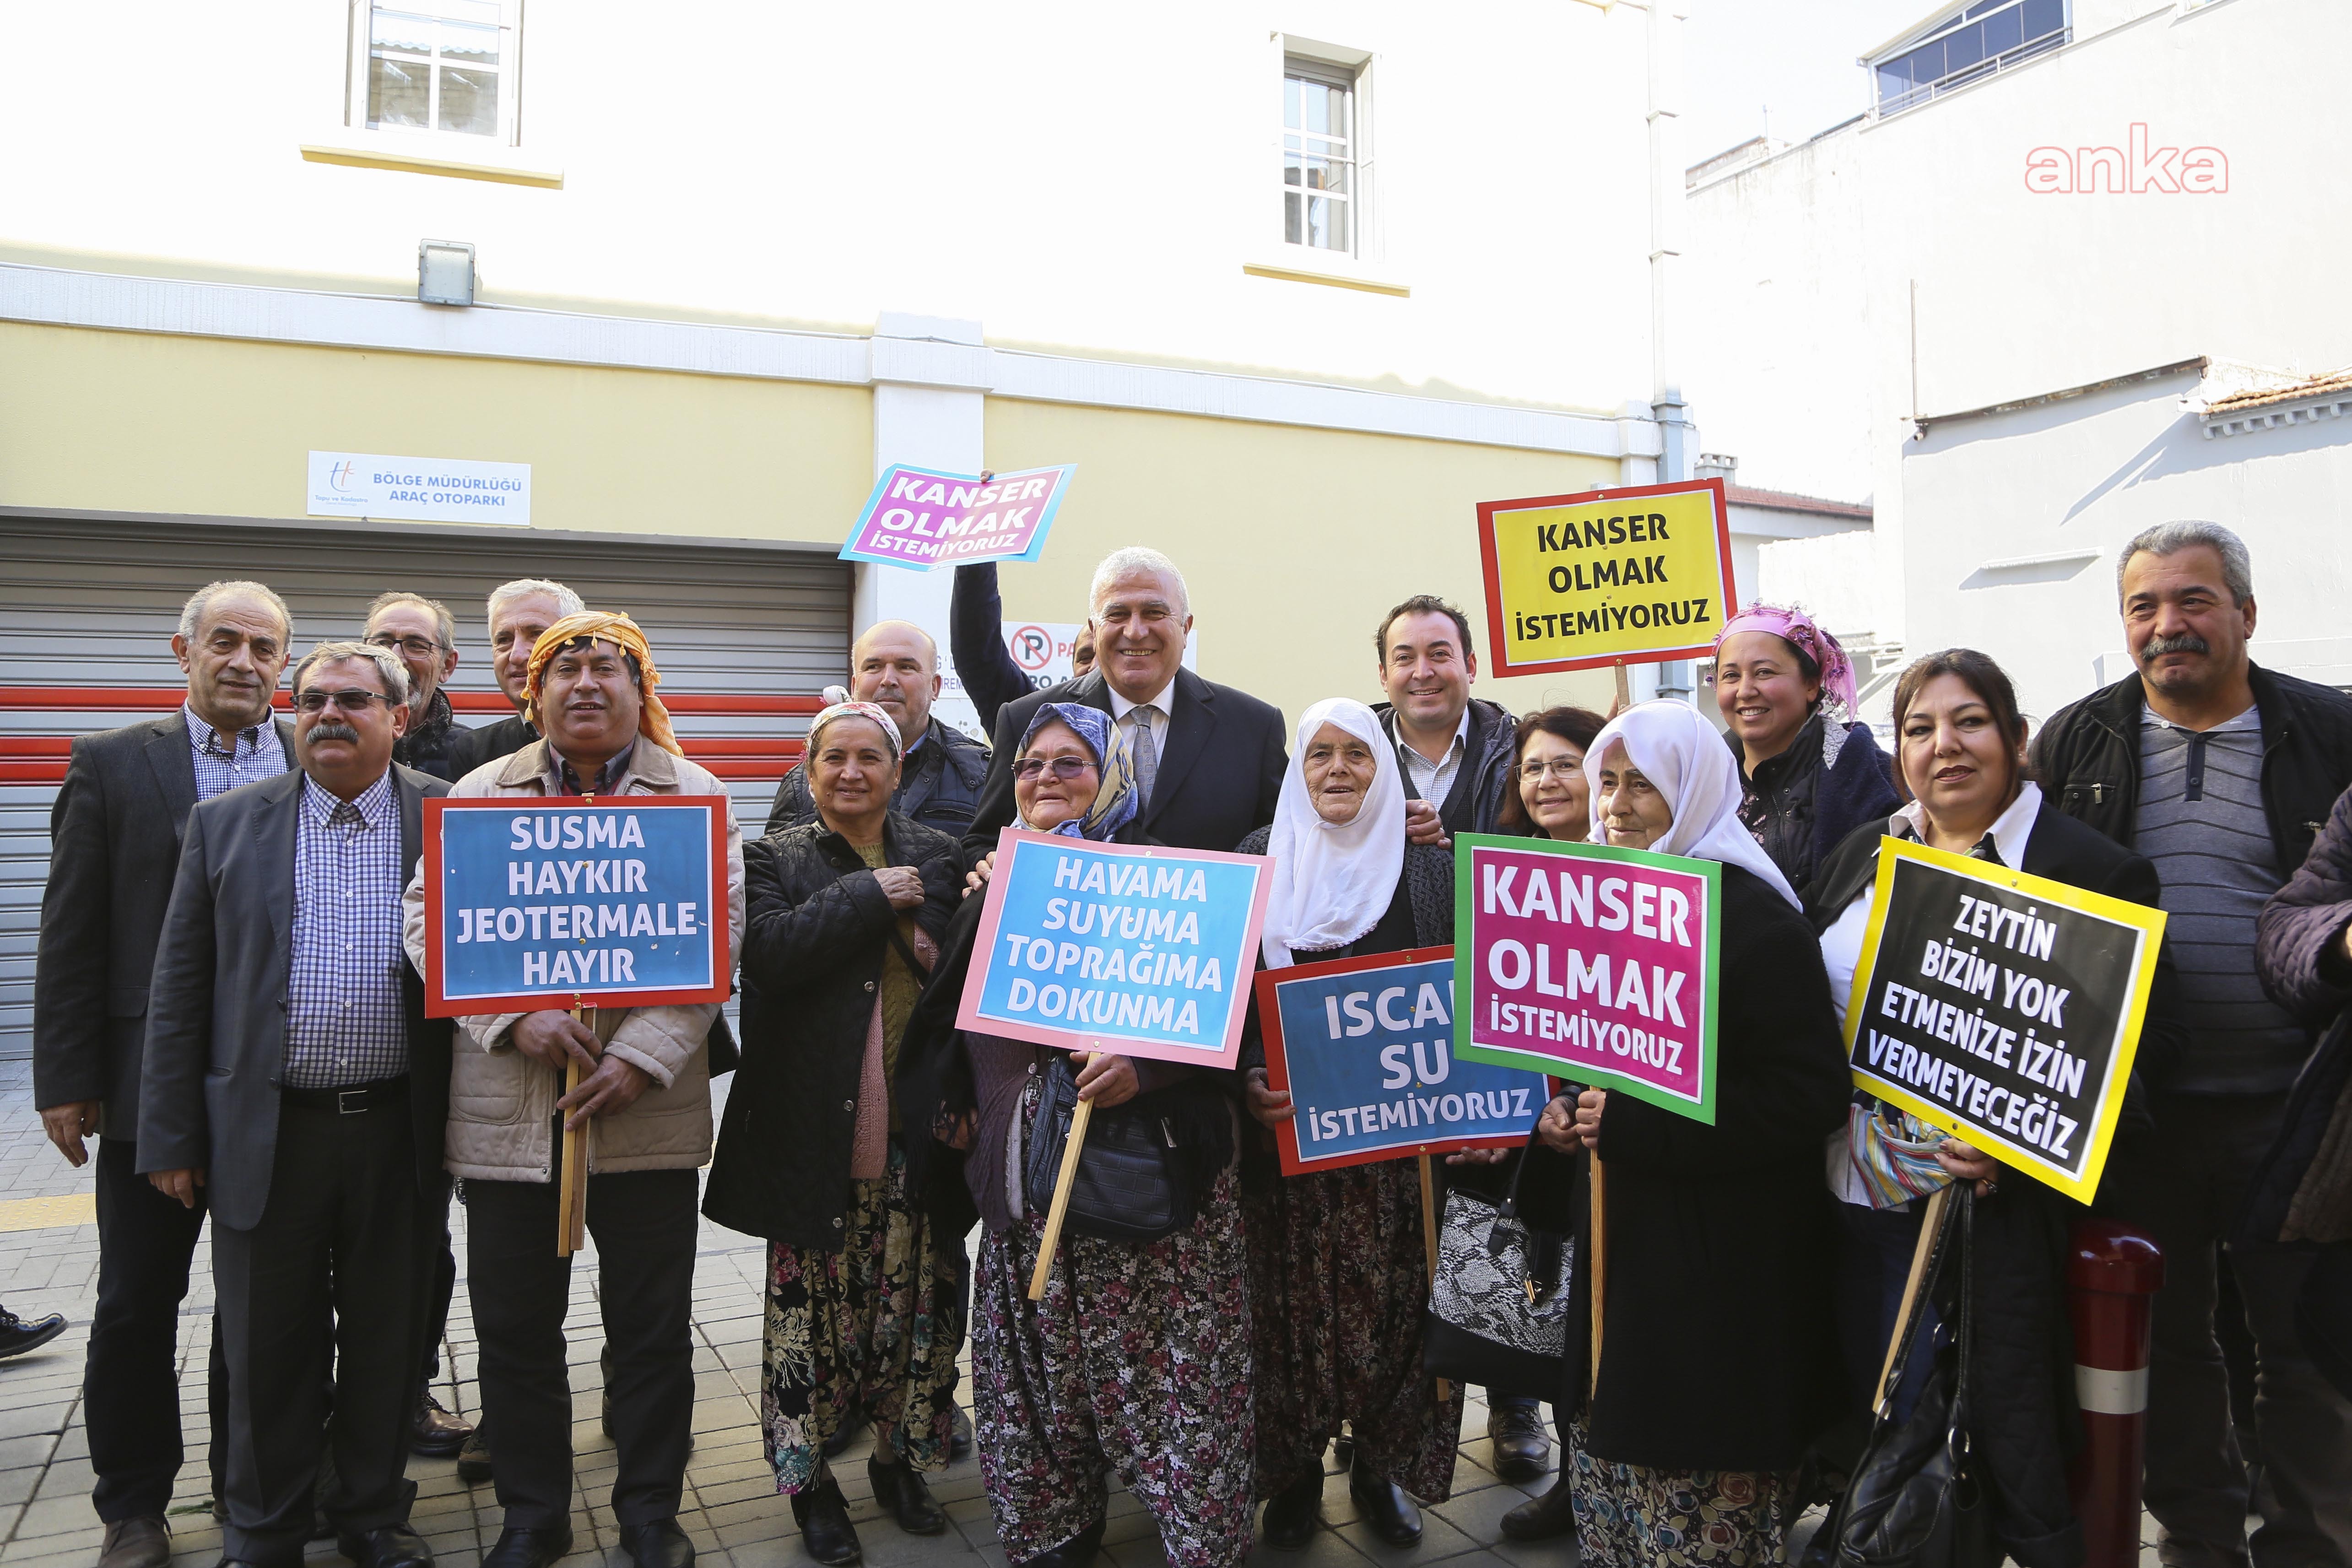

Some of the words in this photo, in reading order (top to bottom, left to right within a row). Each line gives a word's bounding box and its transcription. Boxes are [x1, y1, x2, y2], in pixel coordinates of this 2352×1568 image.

[373, 471, 422, 486] BÖLGE
[427, 474, 522, 492] MÜDÜRLÜĞÜ
[389, 490, 428, 505] ARAÇ
[433, 493, 505, 506] OTOPARKI
[890, 477, 1047, 508] KANSER
[869, 530, 1020, 557] İSTEMİYORUZ
[881, 506, 1033, 539] OLMAK
[1537, 513, 1670, 552] KANSER
[1548, 555, 1668, 593] OLMAK
[1515, 599, 1710, 641] İSTEMİYORUZ
[511, 815, 645, 850] SUSMA
[508, 859, 648, 895] HAYKIR
[1054, 856, 1207, 902] HAVAMA
[457, 902, 697, 943] JEOTERMALE
[1042, 898, 1200, 945] SUYUMA
[1482, 863, 1692, 948] KANSER
[1953, 894, 2057, 962] ZEYTİN
[523, 948, 637, 985] HAYIR
[1006, 934, 1222, 992] TOPRAĞIMA
[1487, 939, 1687, 1028] OLMAK
[1921, 937, 1997, 1001] BİZİM
[2002, 968, 2071, 1028] YOK
[1007, 978, 1200, 1035] DOKUNMA
[1325, 979, 1454, 1039] ISCA
[1491, 993, 1683, 1076] İSTEMİYORUZ
[1881, 982, 2017, 1069] ETMENİZE
[2017, 1028, 2087, 1098] İZİN
[1379, 1038, 1449, 1090] SU
[1308, 1088, 1533, 1142] İSTEMİYORUZ
[1869, 1029, 2078, 1160] VERMEYECEĞİZ
